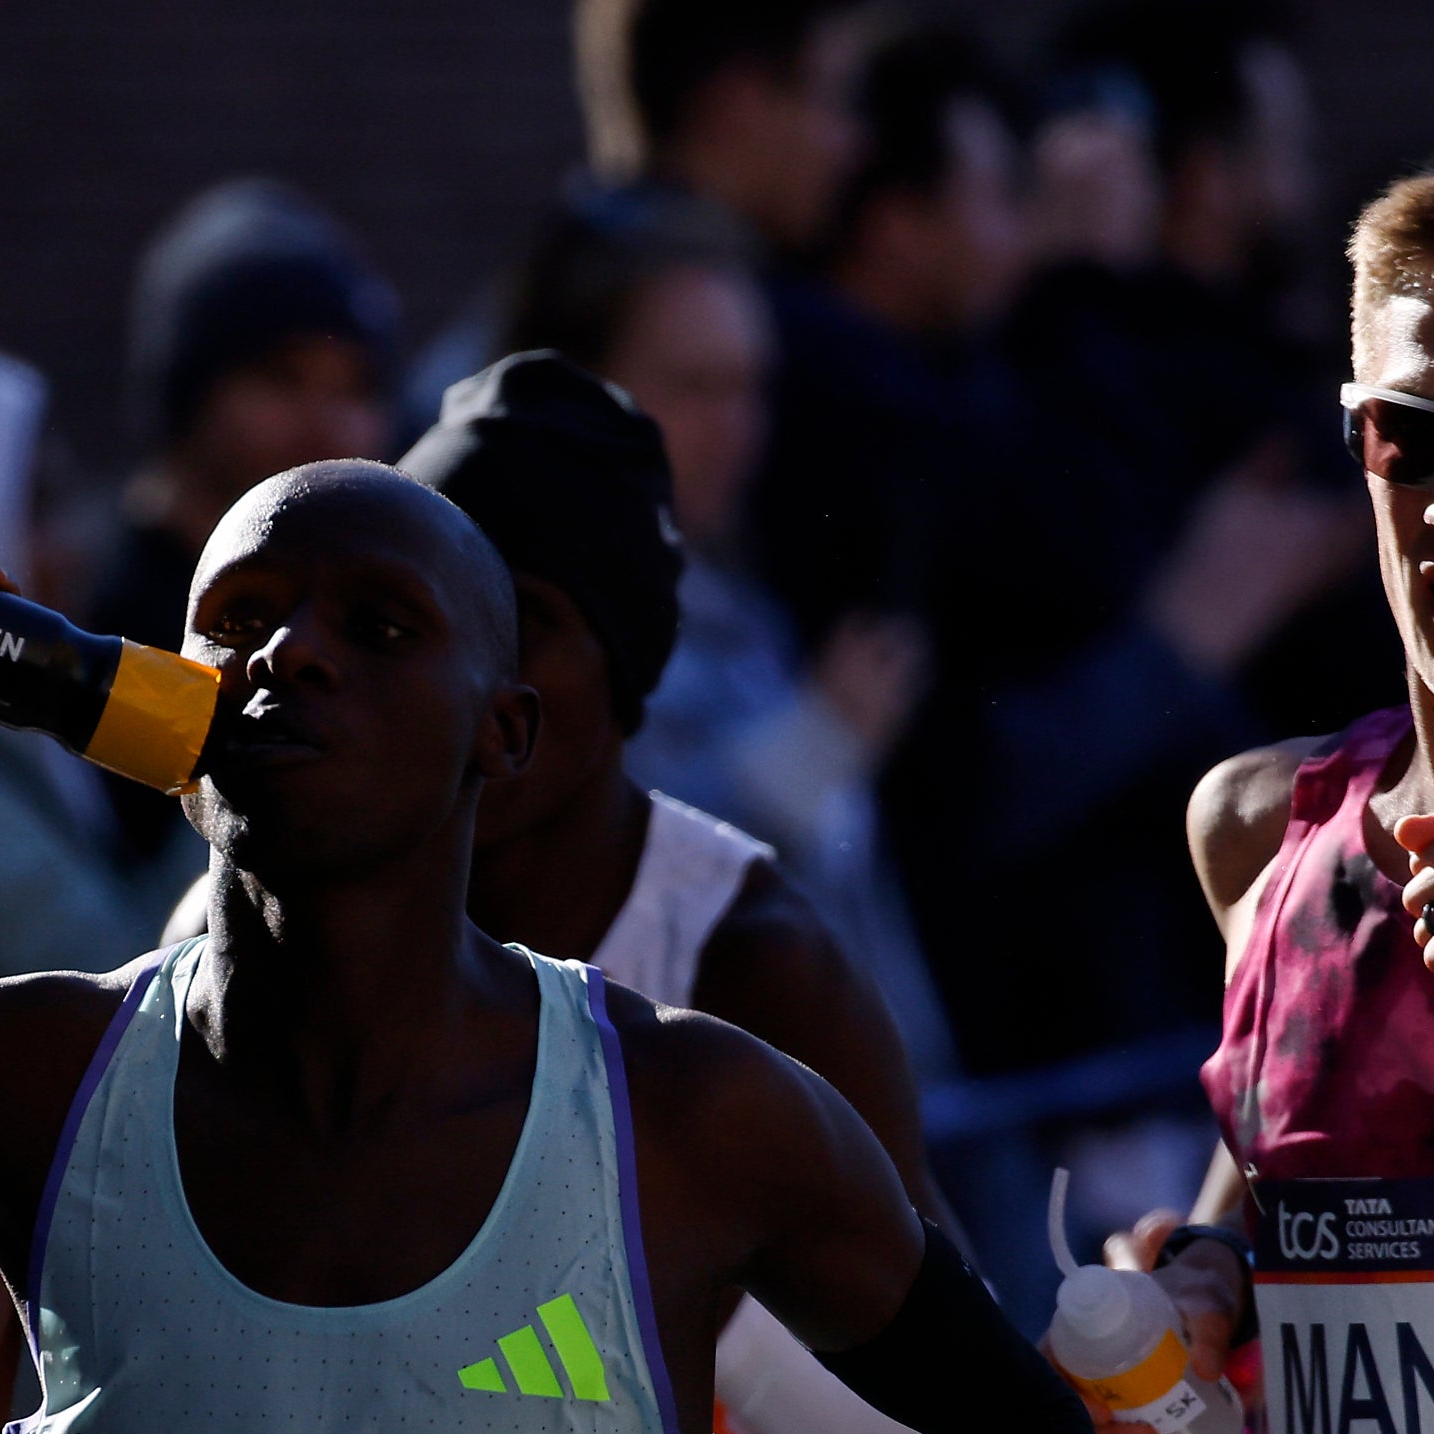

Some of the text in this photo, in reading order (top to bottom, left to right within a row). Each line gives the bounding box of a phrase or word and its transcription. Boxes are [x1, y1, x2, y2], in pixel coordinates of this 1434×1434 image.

[1343, 1198, 1393, 1216] TATA
[1278, 1198, 1340, 1261] tcs
[1346, 1241, 1422, 1261] SERVICES
